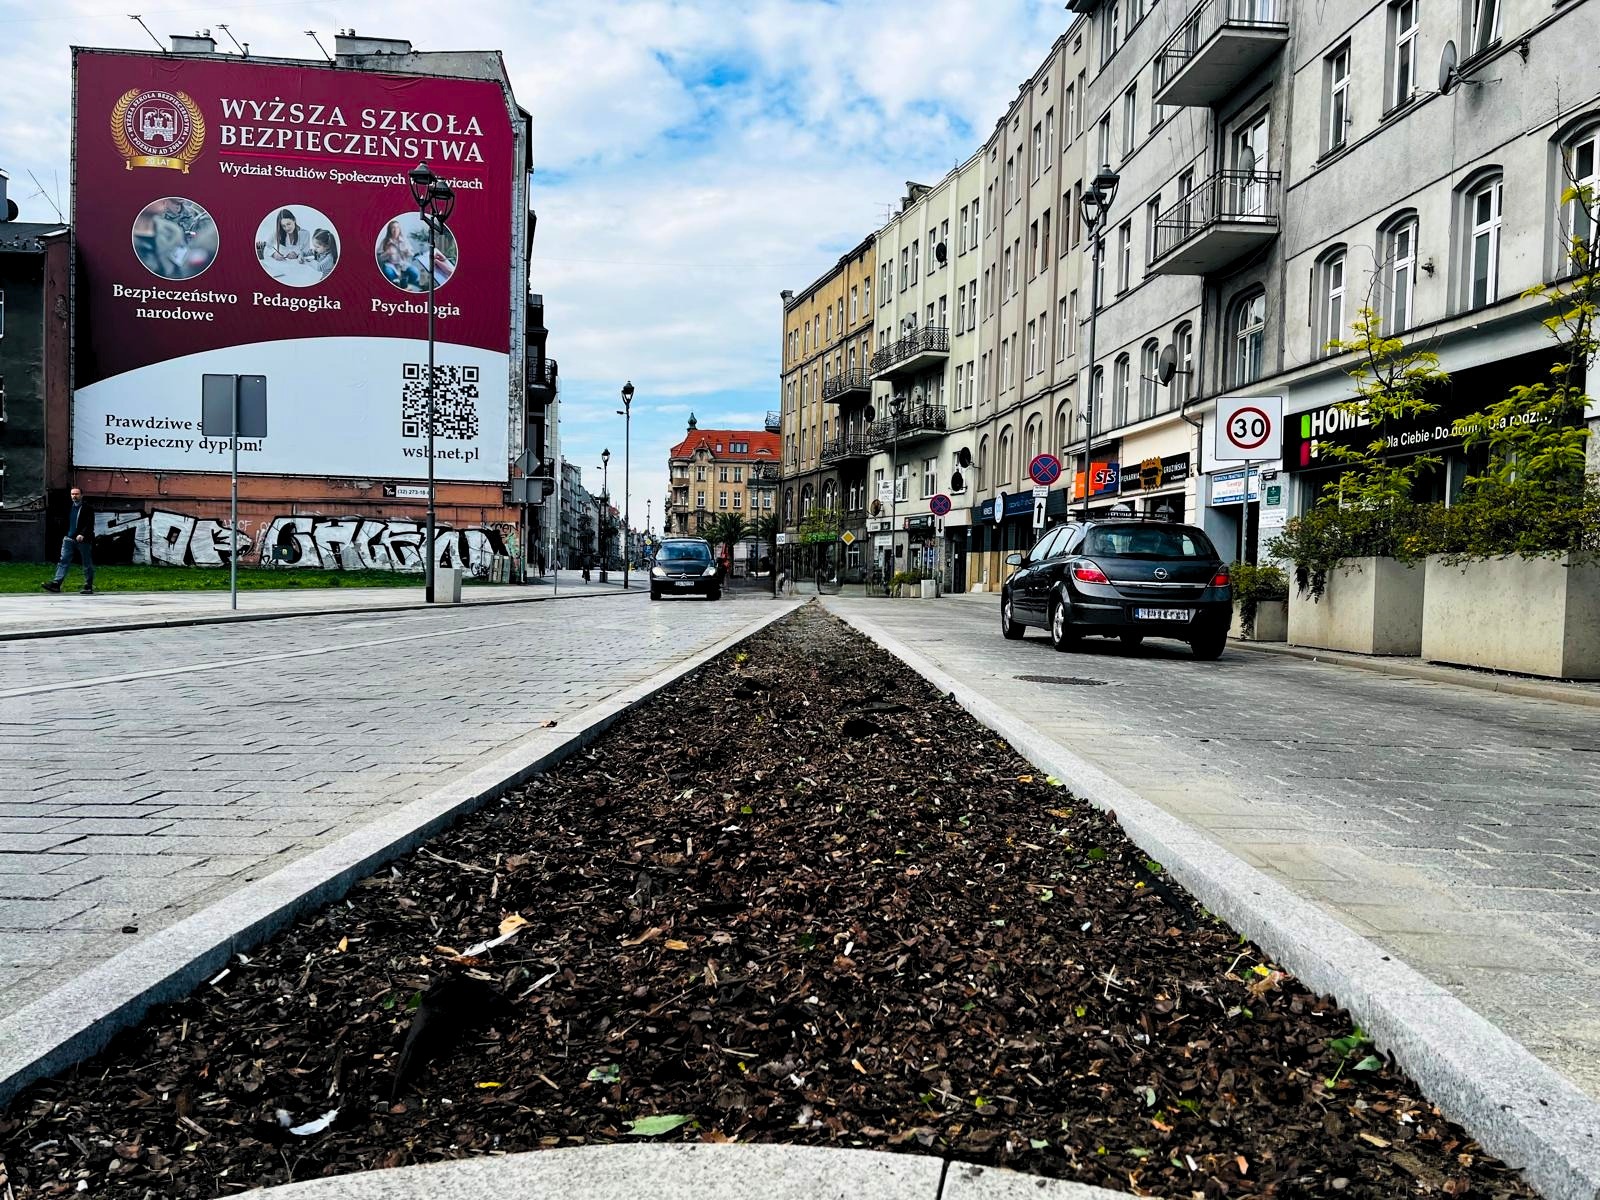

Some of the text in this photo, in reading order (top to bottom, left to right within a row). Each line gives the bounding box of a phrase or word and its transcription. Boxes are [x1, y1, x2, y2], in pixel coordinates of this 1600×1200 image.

[219, 96, 484, 136] WYŻSZA SZKOŁA
[219, 125, 485, 163] BEZPIECZEŃSTWA
[219, 161, 273, 177] Wydział
[274, 165, 327, 180] Studiów
[329, 169, 406, 187] Społecznych
[112, 284, 238, 303] Bezpieczeństwo
[252, 292, 342, 312] Pedagogika
[136, 306, 214, 322] narodowe
[105, 414, 193, 430] Prawdziwe
[1233, 418, 1265, 438] 30
[1311, 399, 1371, 437] HOME
[105, 433, 263, 454] Bezpieczny dyplom!
[1400, 429, 1430, 446] Ciebie
[1434, 426, 1449, 440] Do
[1095, 468, 1116, 484] STS
